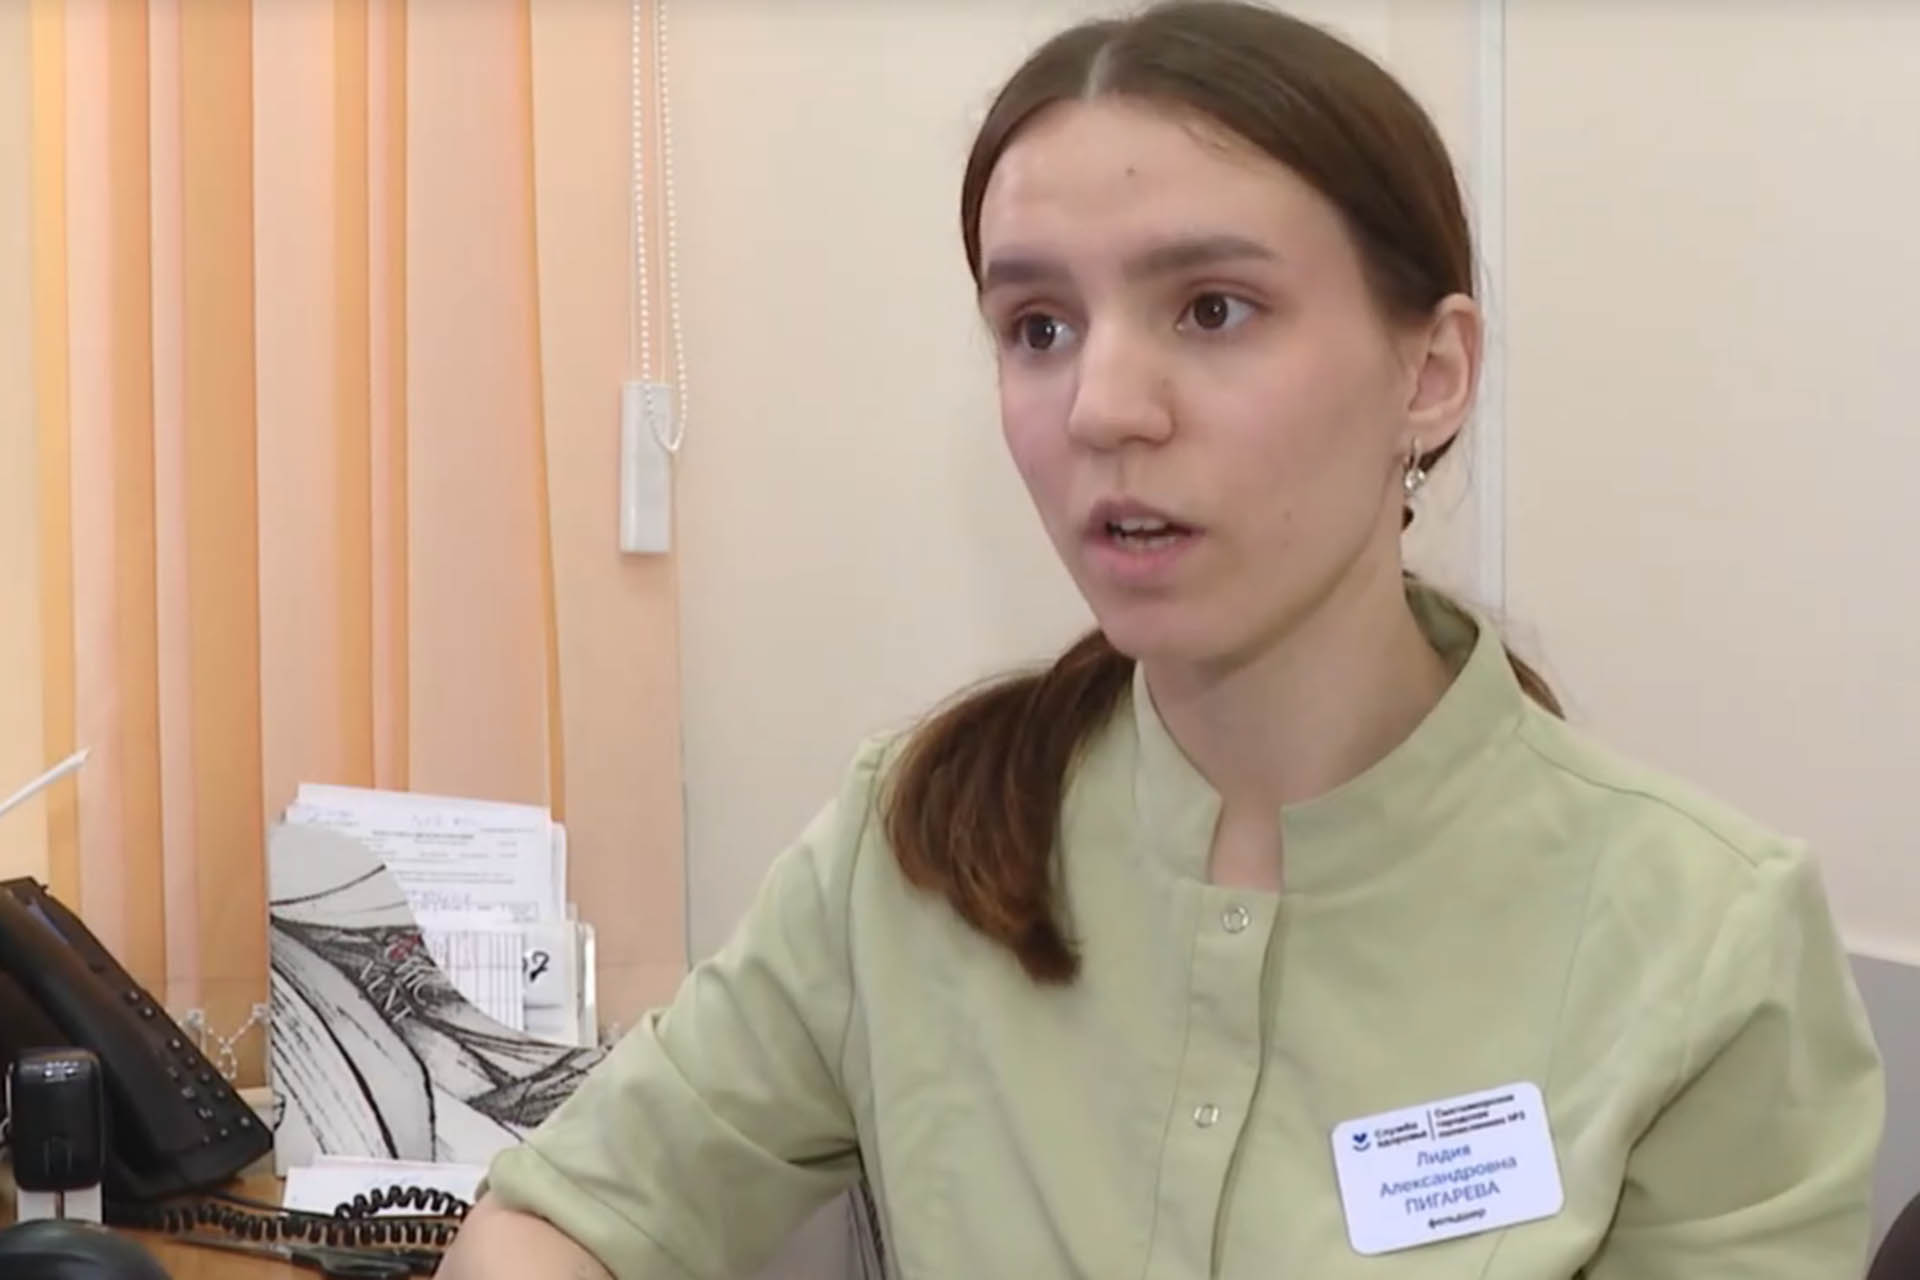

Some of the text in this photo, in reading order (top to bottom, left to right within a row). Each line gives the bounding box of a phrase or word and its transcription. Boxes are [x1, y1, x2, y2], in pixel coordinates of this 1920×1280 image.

[1416, 1144, 1472, 1168] Лидия
[1379, 1156, 1518, 1198] Александровна
[1405, 1180, 1501, 1215] ПИГАРЕВА
